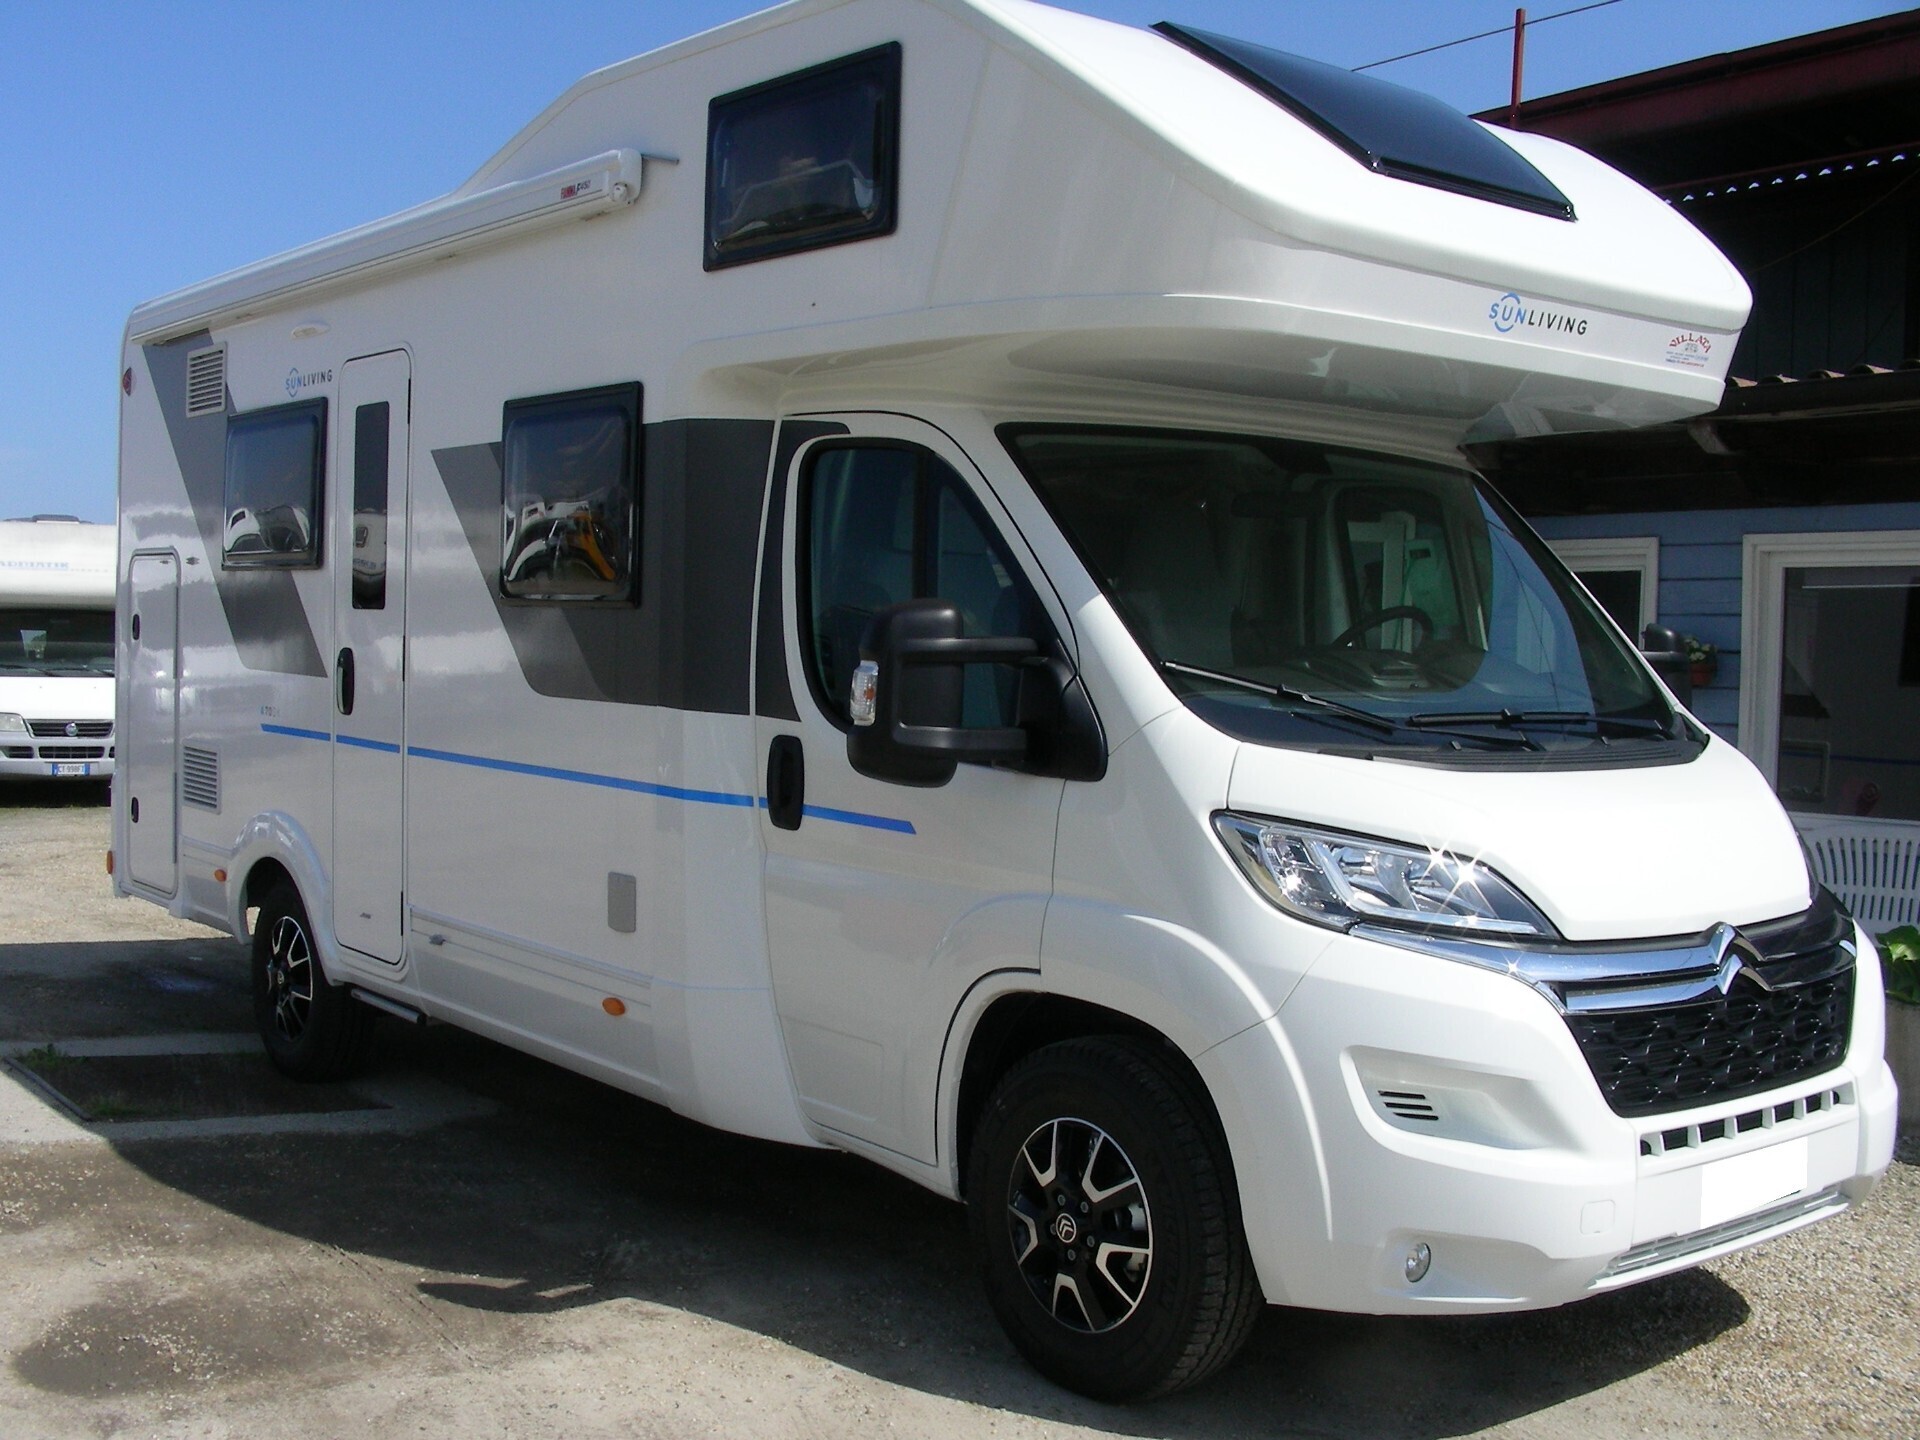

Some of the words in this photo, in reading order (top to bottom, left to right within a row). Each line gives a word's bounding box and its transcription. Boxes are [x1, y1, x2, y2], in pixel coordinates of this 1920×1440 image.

[1489, 303, 1588, 336] SUNLIVING
[1668, 332, 1712, 354] VILLATA
[285, 369, 333, 390] SUNLIVING
